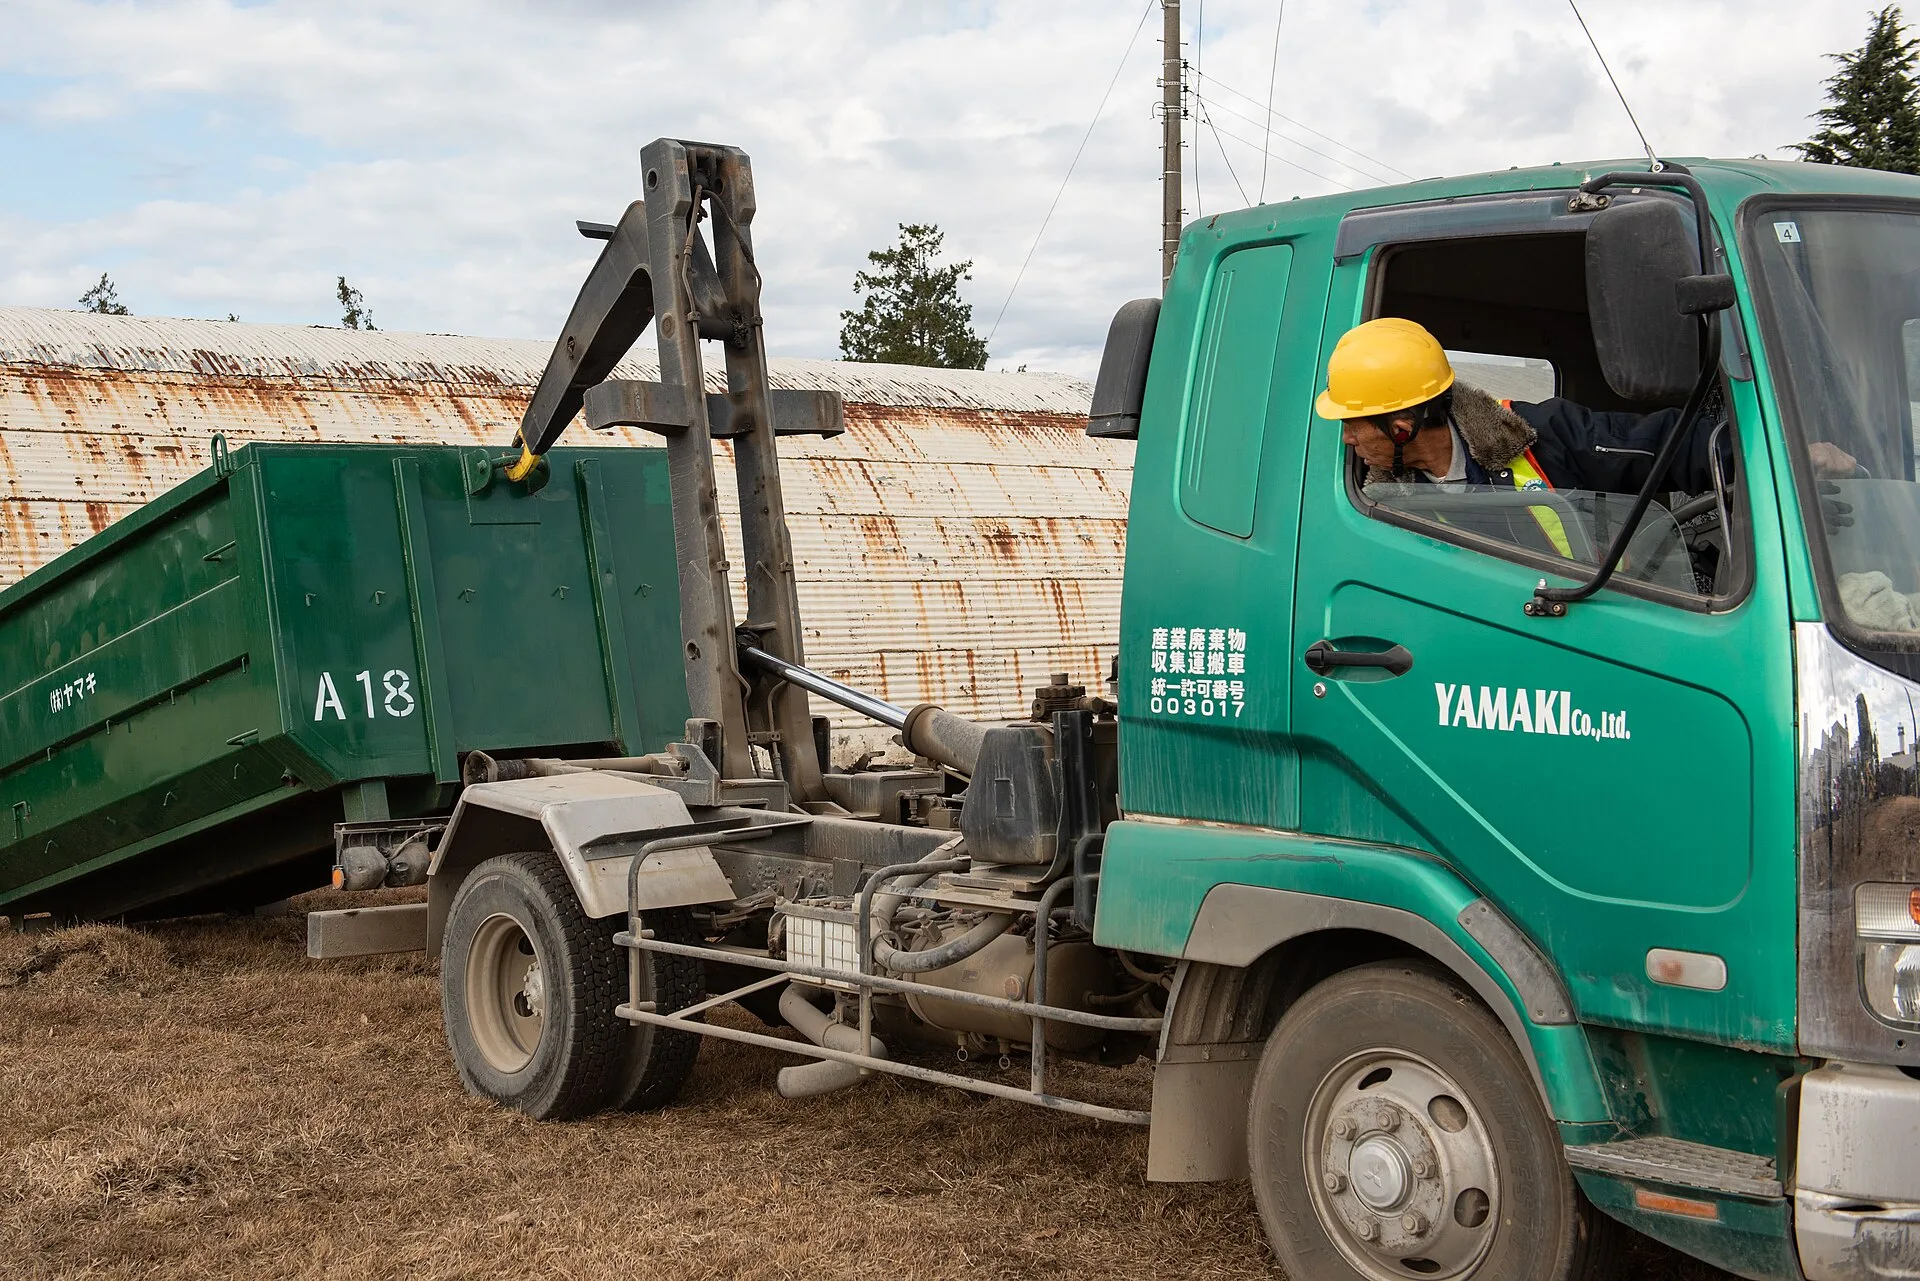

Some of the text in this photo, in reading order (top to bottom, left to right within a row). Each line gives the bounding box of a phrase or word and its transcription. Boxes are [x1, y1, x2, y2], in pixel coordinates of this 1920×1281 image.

[1151, 627, 1246, 652] 産業廃棄物
[1151, 650, 1246, 676] 収集運搬車
[1151, 677, 1245, 700] 統一許可番号
[1150, 697, 1245, 718] 003017
[1434, 682, 1571, 736] YAMAKI
